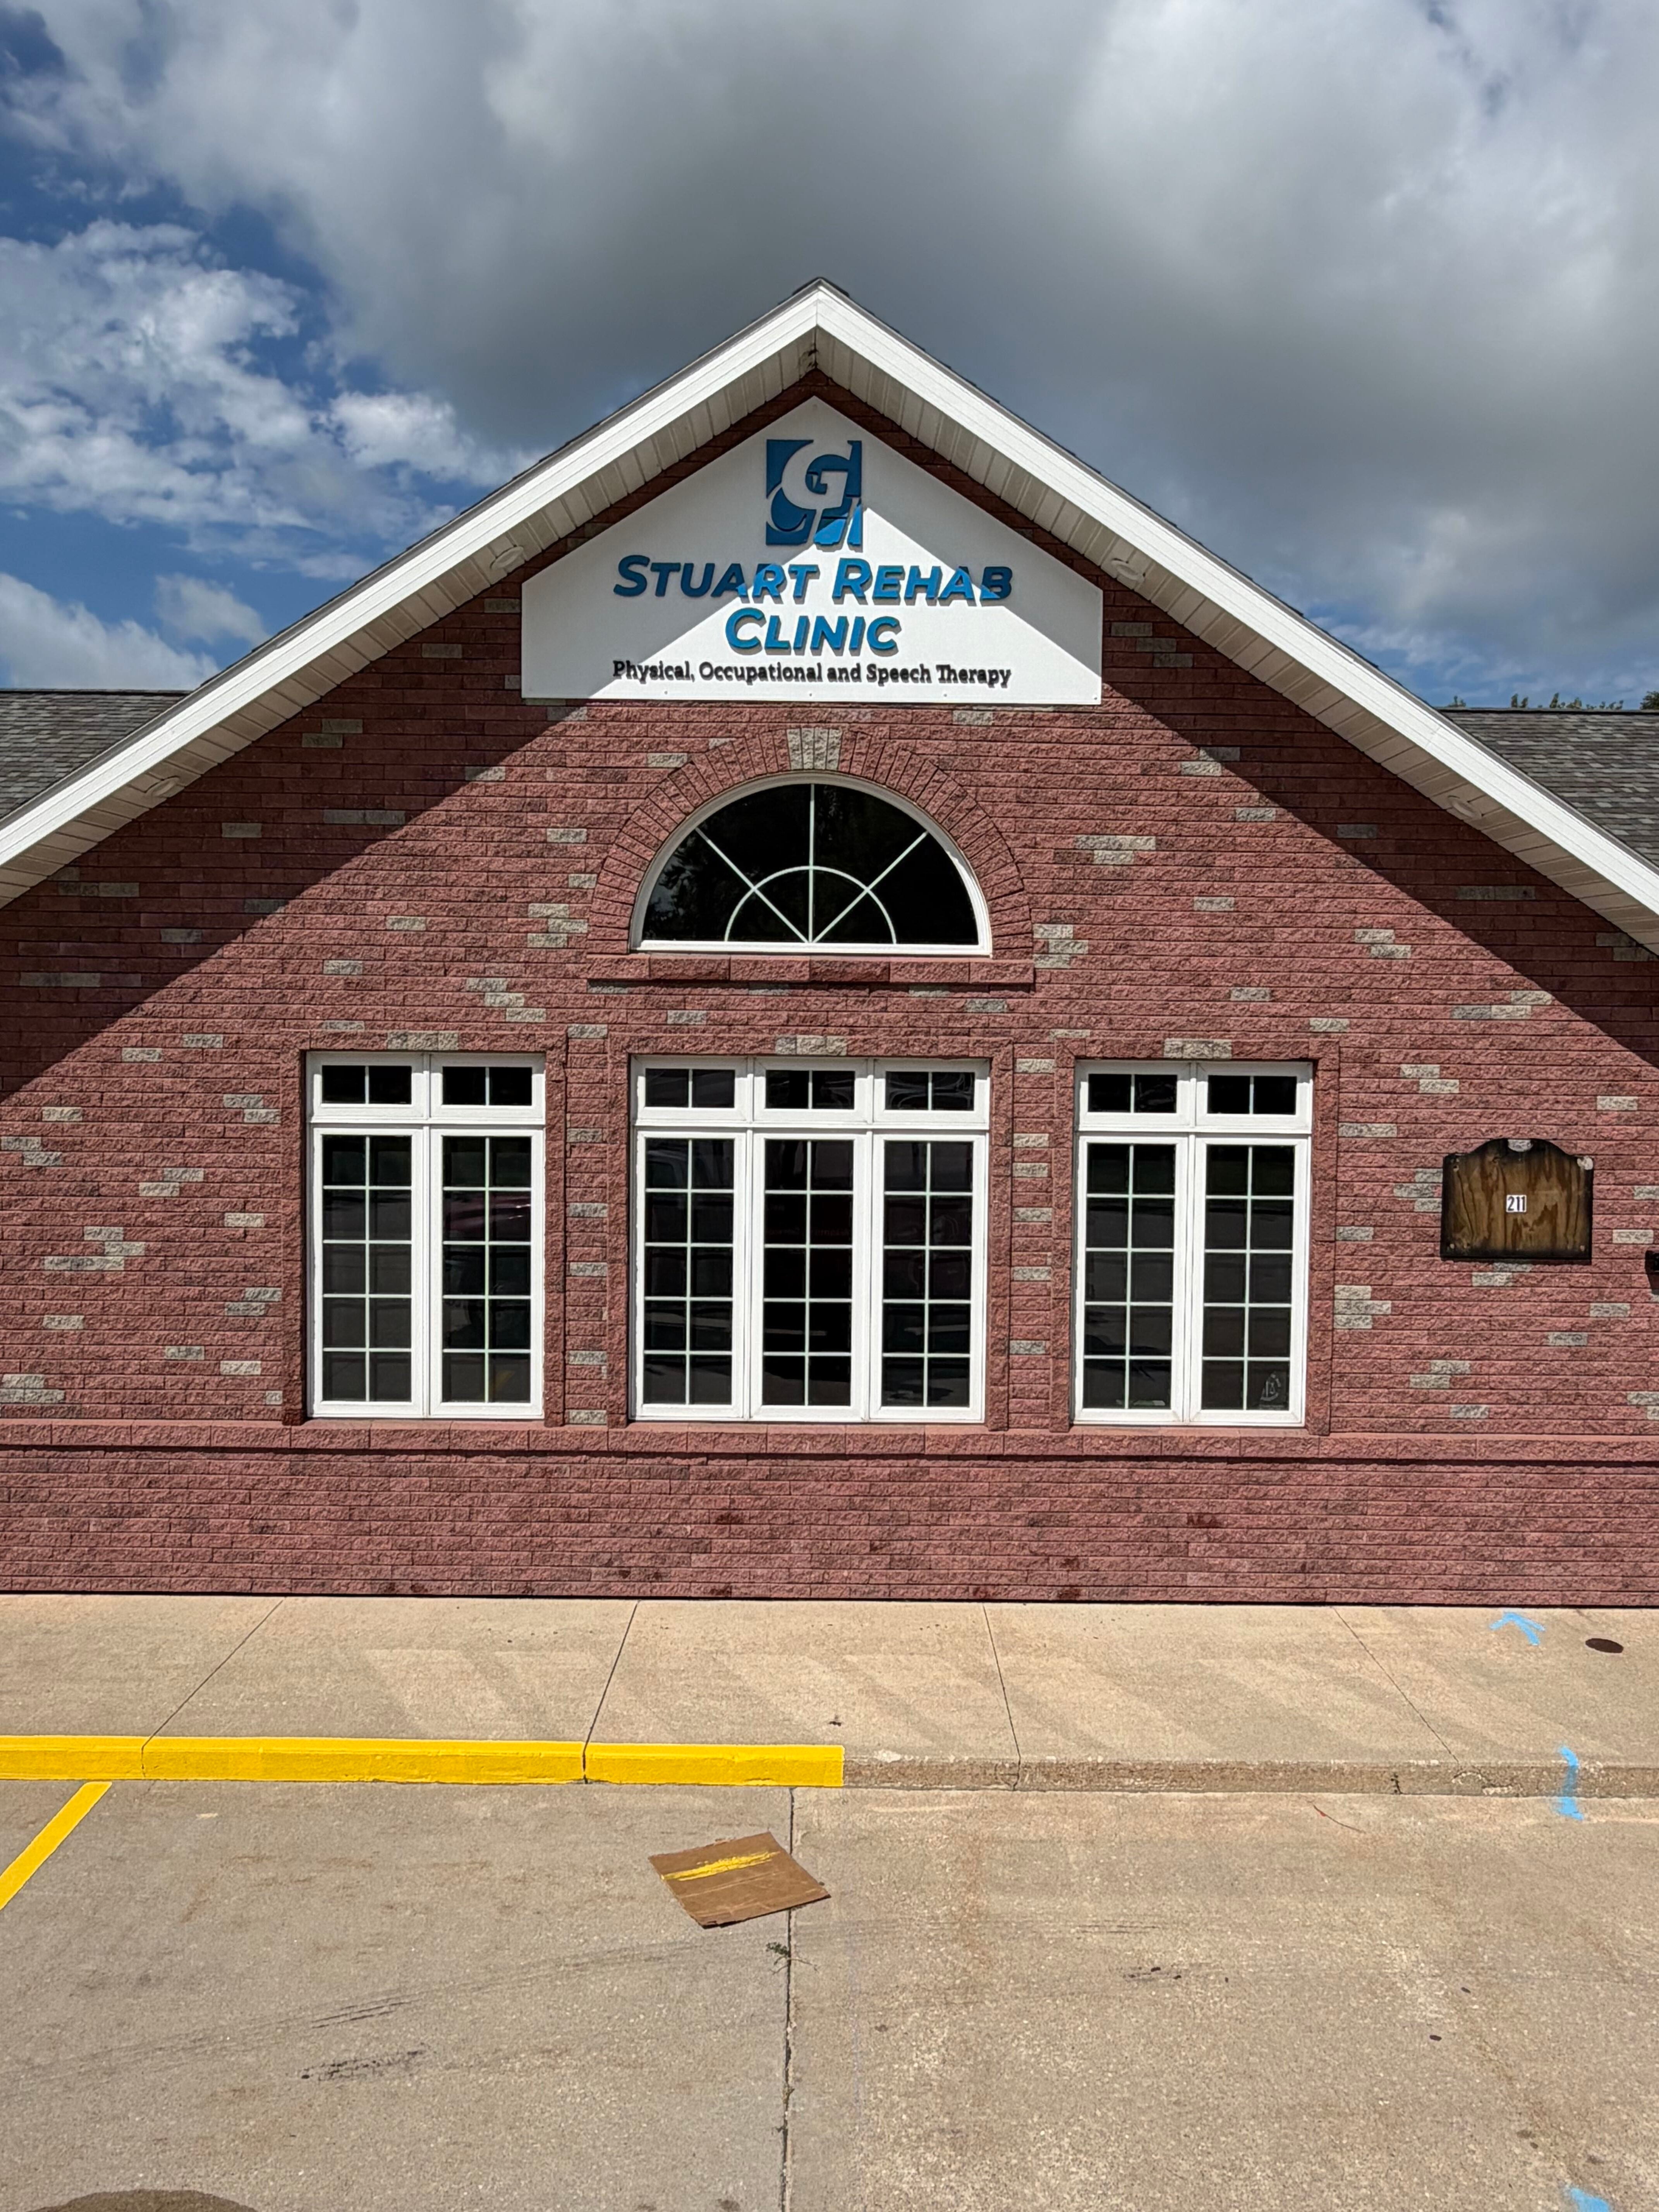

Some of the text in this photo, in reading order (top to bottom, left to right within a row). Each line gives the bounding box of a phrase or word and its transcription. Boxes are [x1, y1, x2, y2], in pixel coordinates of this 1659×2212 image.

[613, 555, 1013, 600] STUART REHAB
[725, 607, 899, 651] CLINIC
[613, 660, 1012, 687] Physical, Occupational and Speech Therapy
[1508, 1196, 1525, 1211] 211
